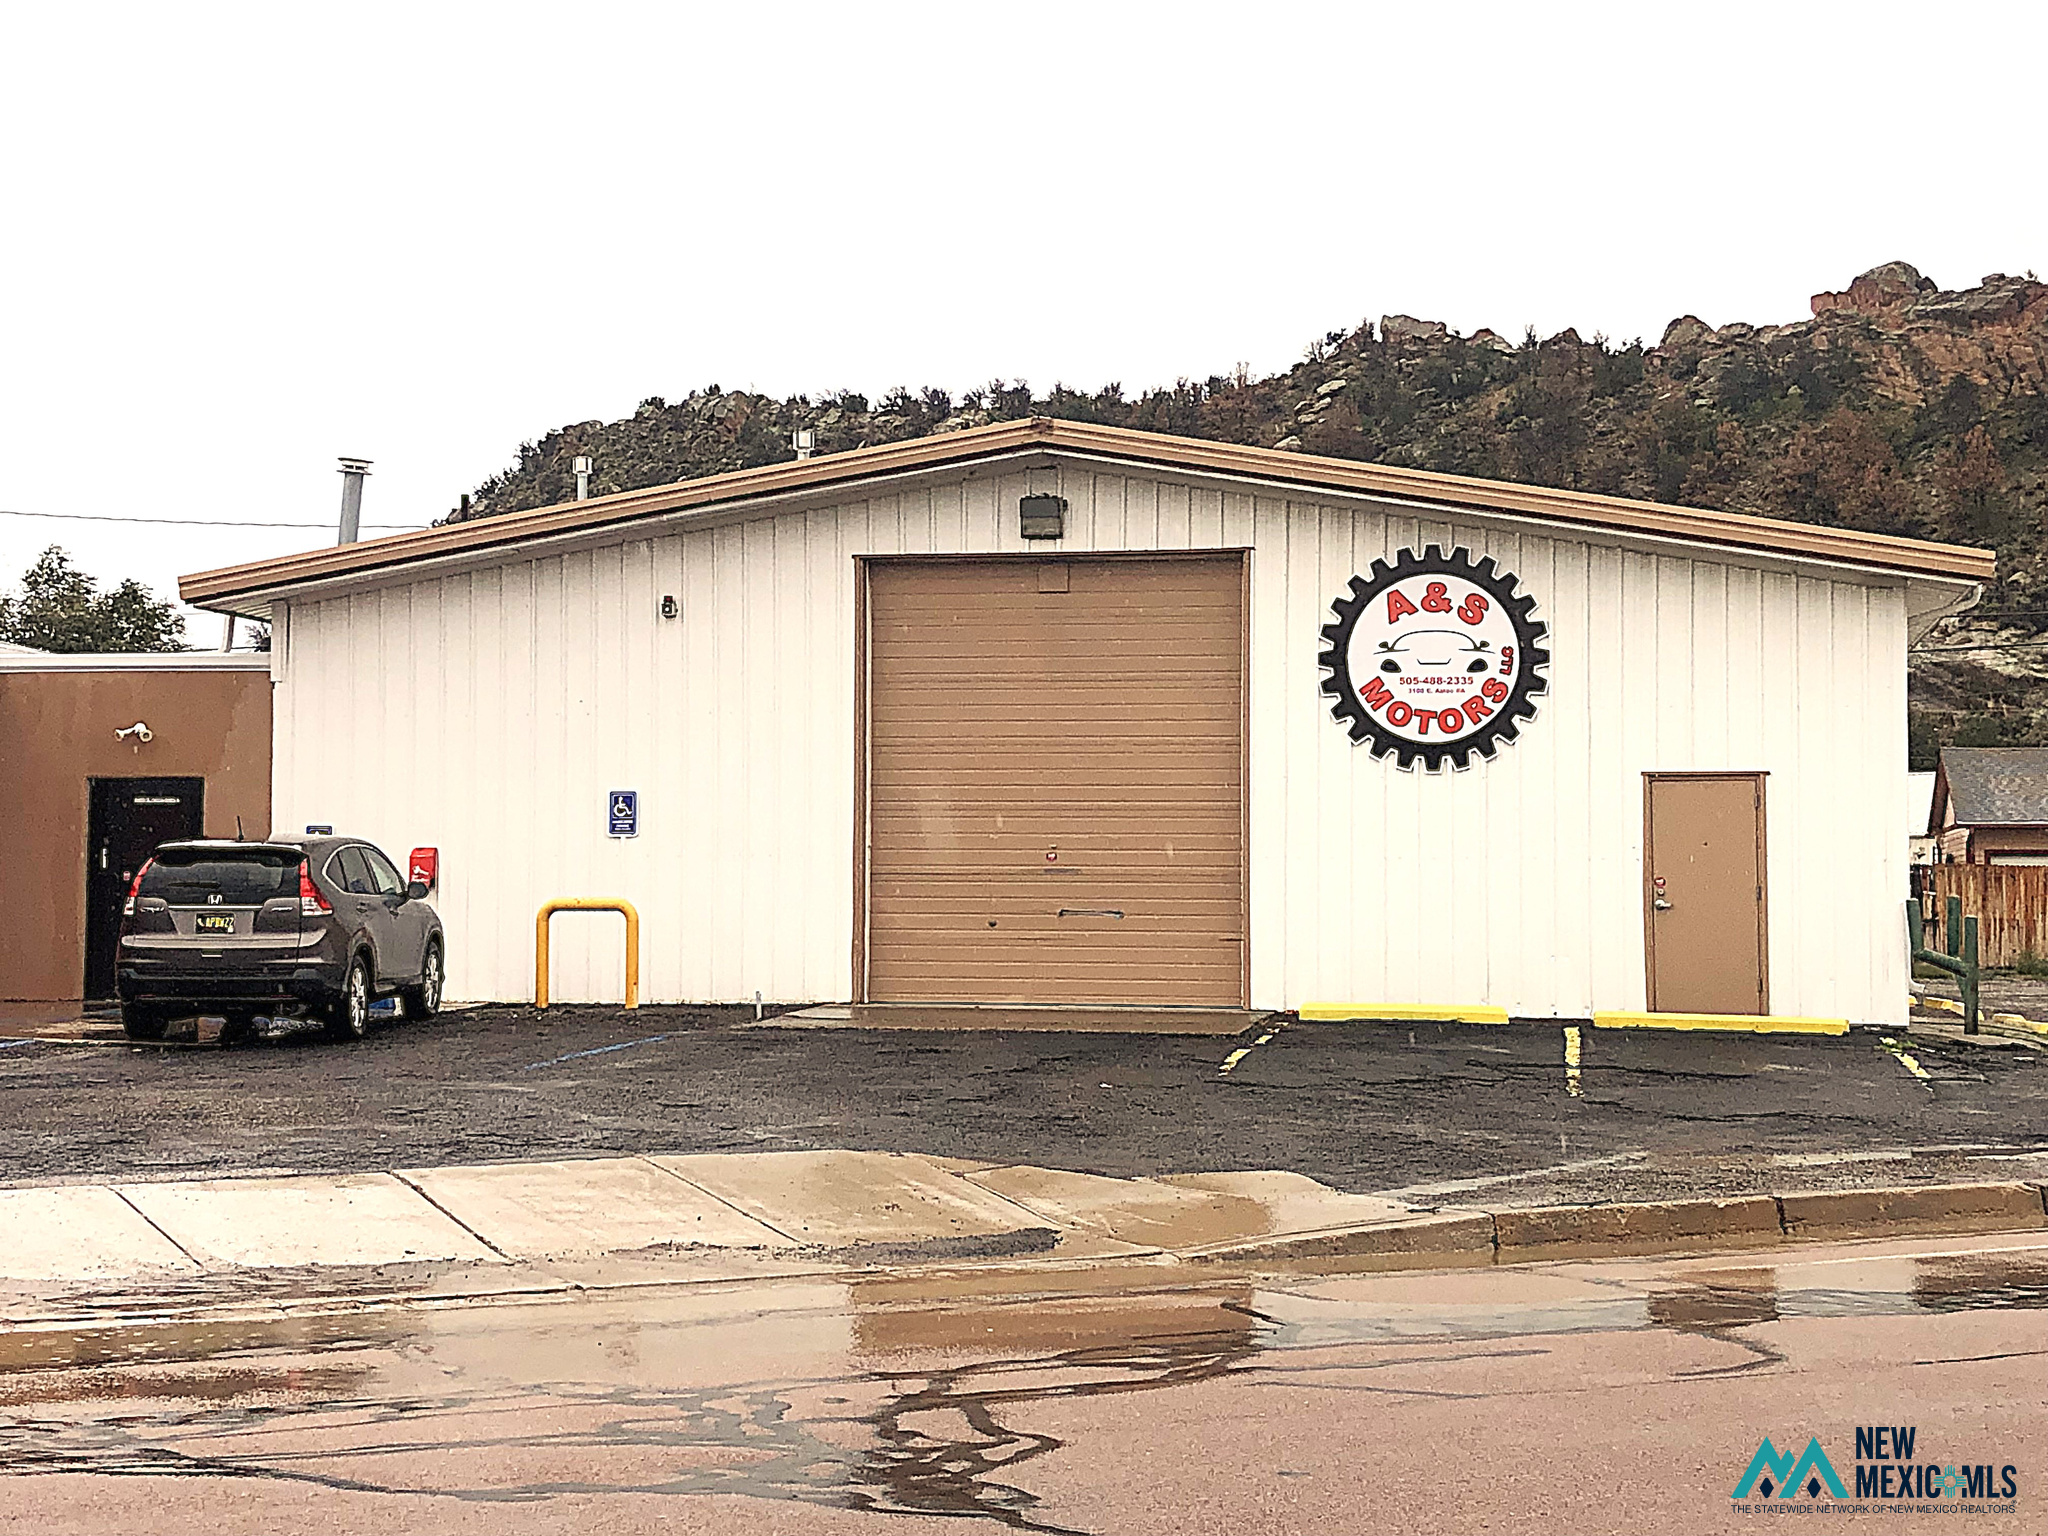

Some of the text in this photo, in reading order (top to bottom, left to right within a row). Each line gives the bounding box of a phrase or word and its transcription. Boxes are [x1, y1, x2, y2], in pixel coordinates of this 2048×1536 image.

[1387, 581, 1490, 625] A&S
[1499, 646, 1514, 676] LLC
[1399, 676, 1474, 685] 505-488-2335
[1359, 676, 1509, 735] MOTORS
